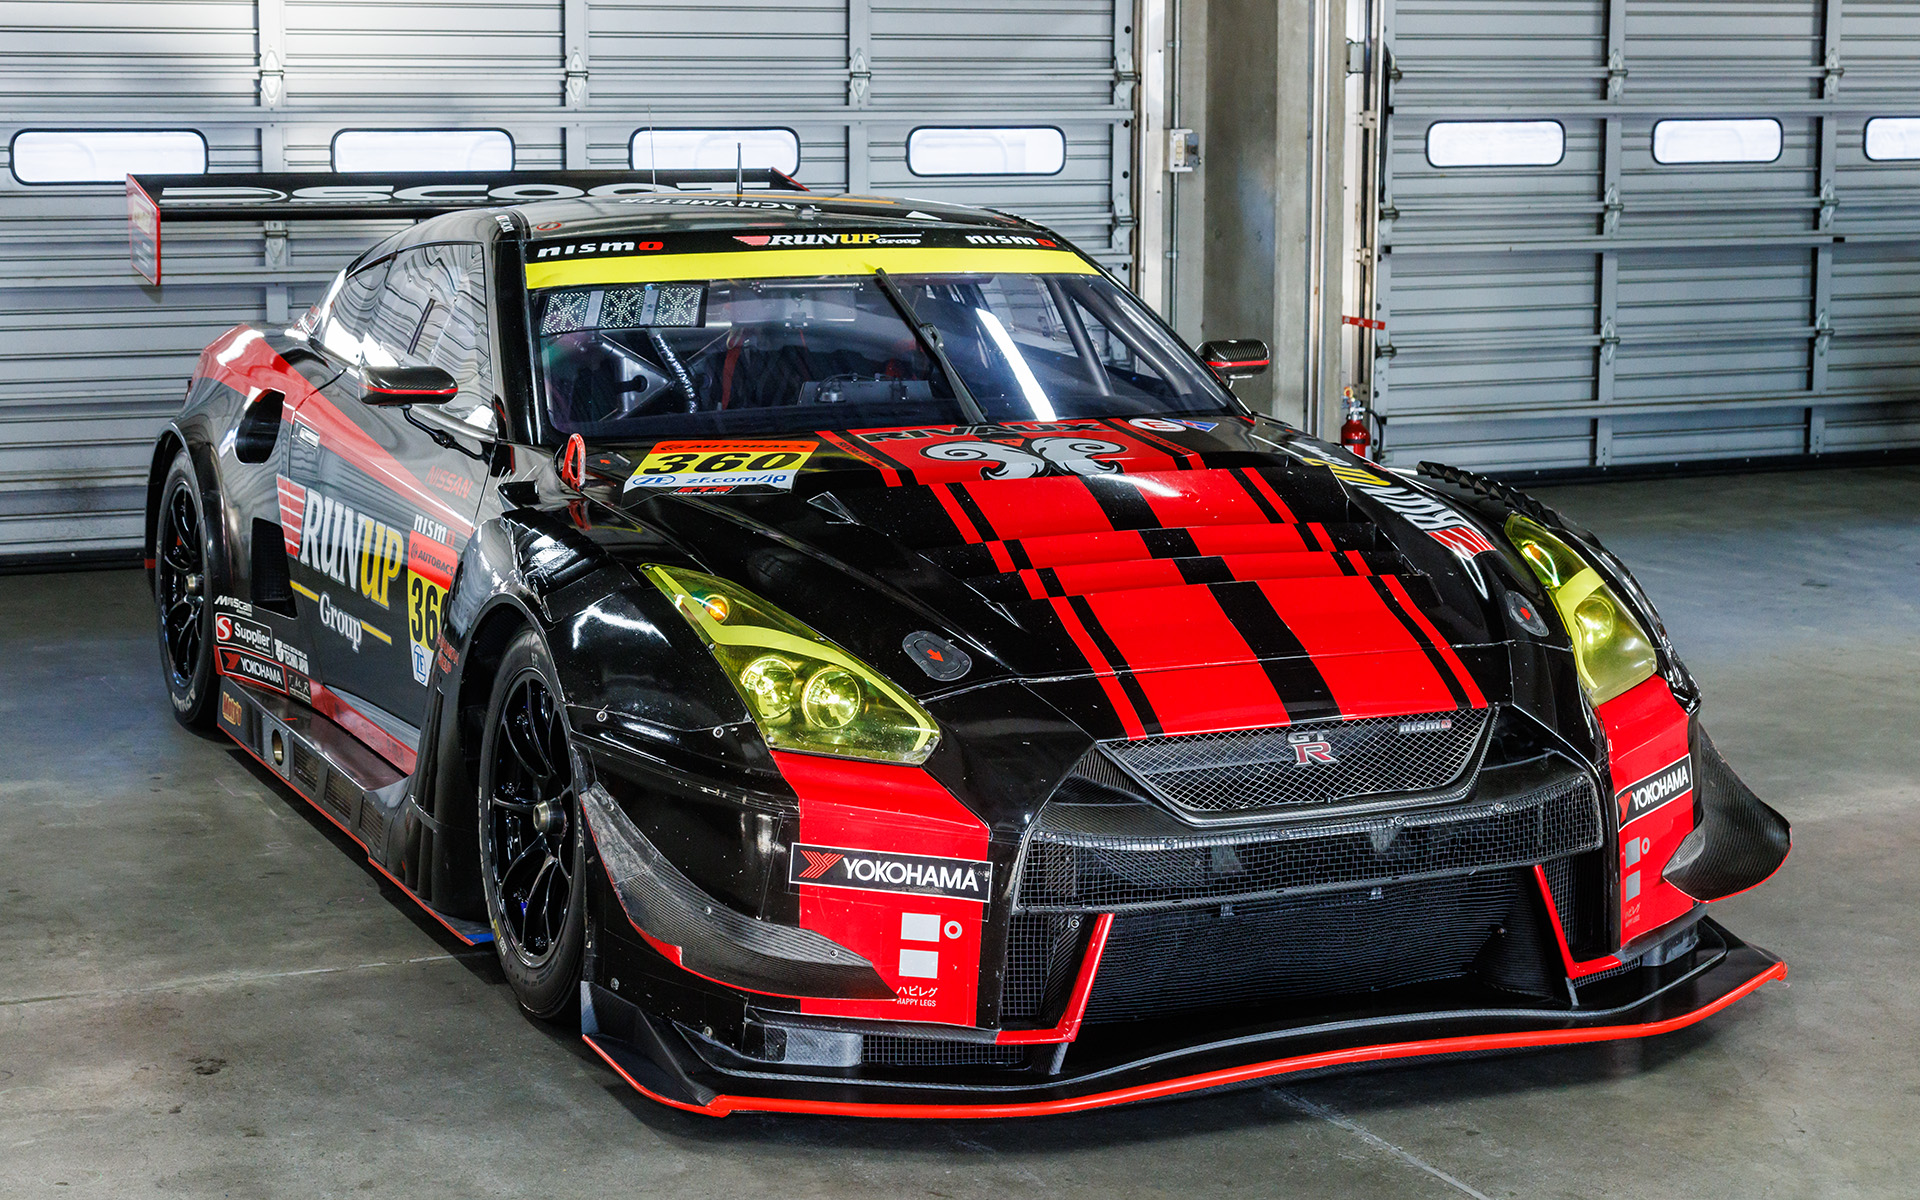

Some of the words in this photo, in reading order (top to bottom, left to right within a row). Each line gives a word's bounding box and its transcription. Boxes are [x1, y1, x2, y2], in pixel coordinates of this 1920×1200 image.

[537, 241, 664, 257] nismo
[768, 232, 878, 247] RUNUP
[876, 236, 921, 246] Group
[965, 235, 1057, 248] nismo
[856, 423, 1113, 443] RIVAUX
[643, 452, 802, 475] 360
[425, 465, 473, 500] NISSAN
[685, 474, 787, 484] zf.com/jp
[414, 514, 456, 547] nismo
[299, 487, 404, 610] RUNUP
[418, 550, 455, 577] AUTOBACS
[234, 622, 270, 648] Supplier
[319, 591, 363, 653] Group
[240, 657, 283, 686] YOKOHAMA
[1399, 720, 1452, 734] nismo
[1632, 766, 1689, 811] YOKOHAMA
[843, 858, 979, 892] YOKOHAMA
[896, 998, 919, 1006] HAPPY
[919, 999, 937, 1008] LEGS
